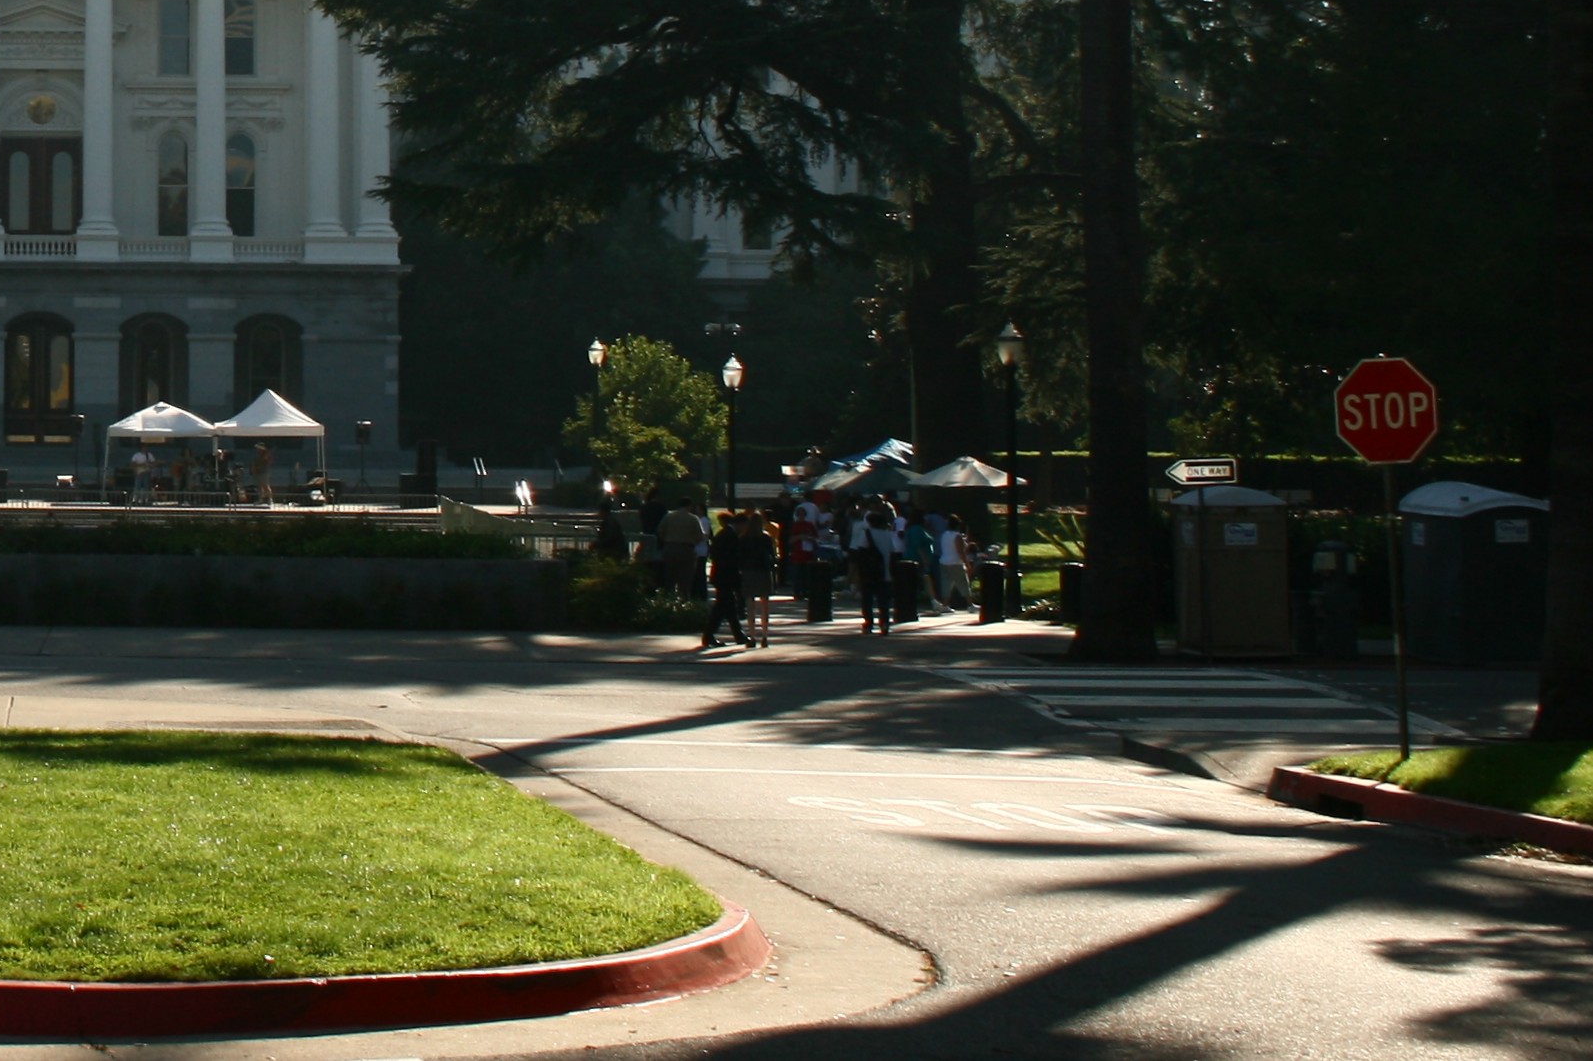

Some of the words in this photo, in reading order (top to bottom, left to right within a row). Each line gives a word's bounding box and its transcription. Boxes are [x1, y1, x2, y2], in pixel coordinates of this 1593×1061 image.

[1343, 392, 1428, 431] STOP
[1187, 467, 1206, 476] ONE
[1208, 466, 1228, 475] WAY
[786, 796, 1184, 835] STOP
